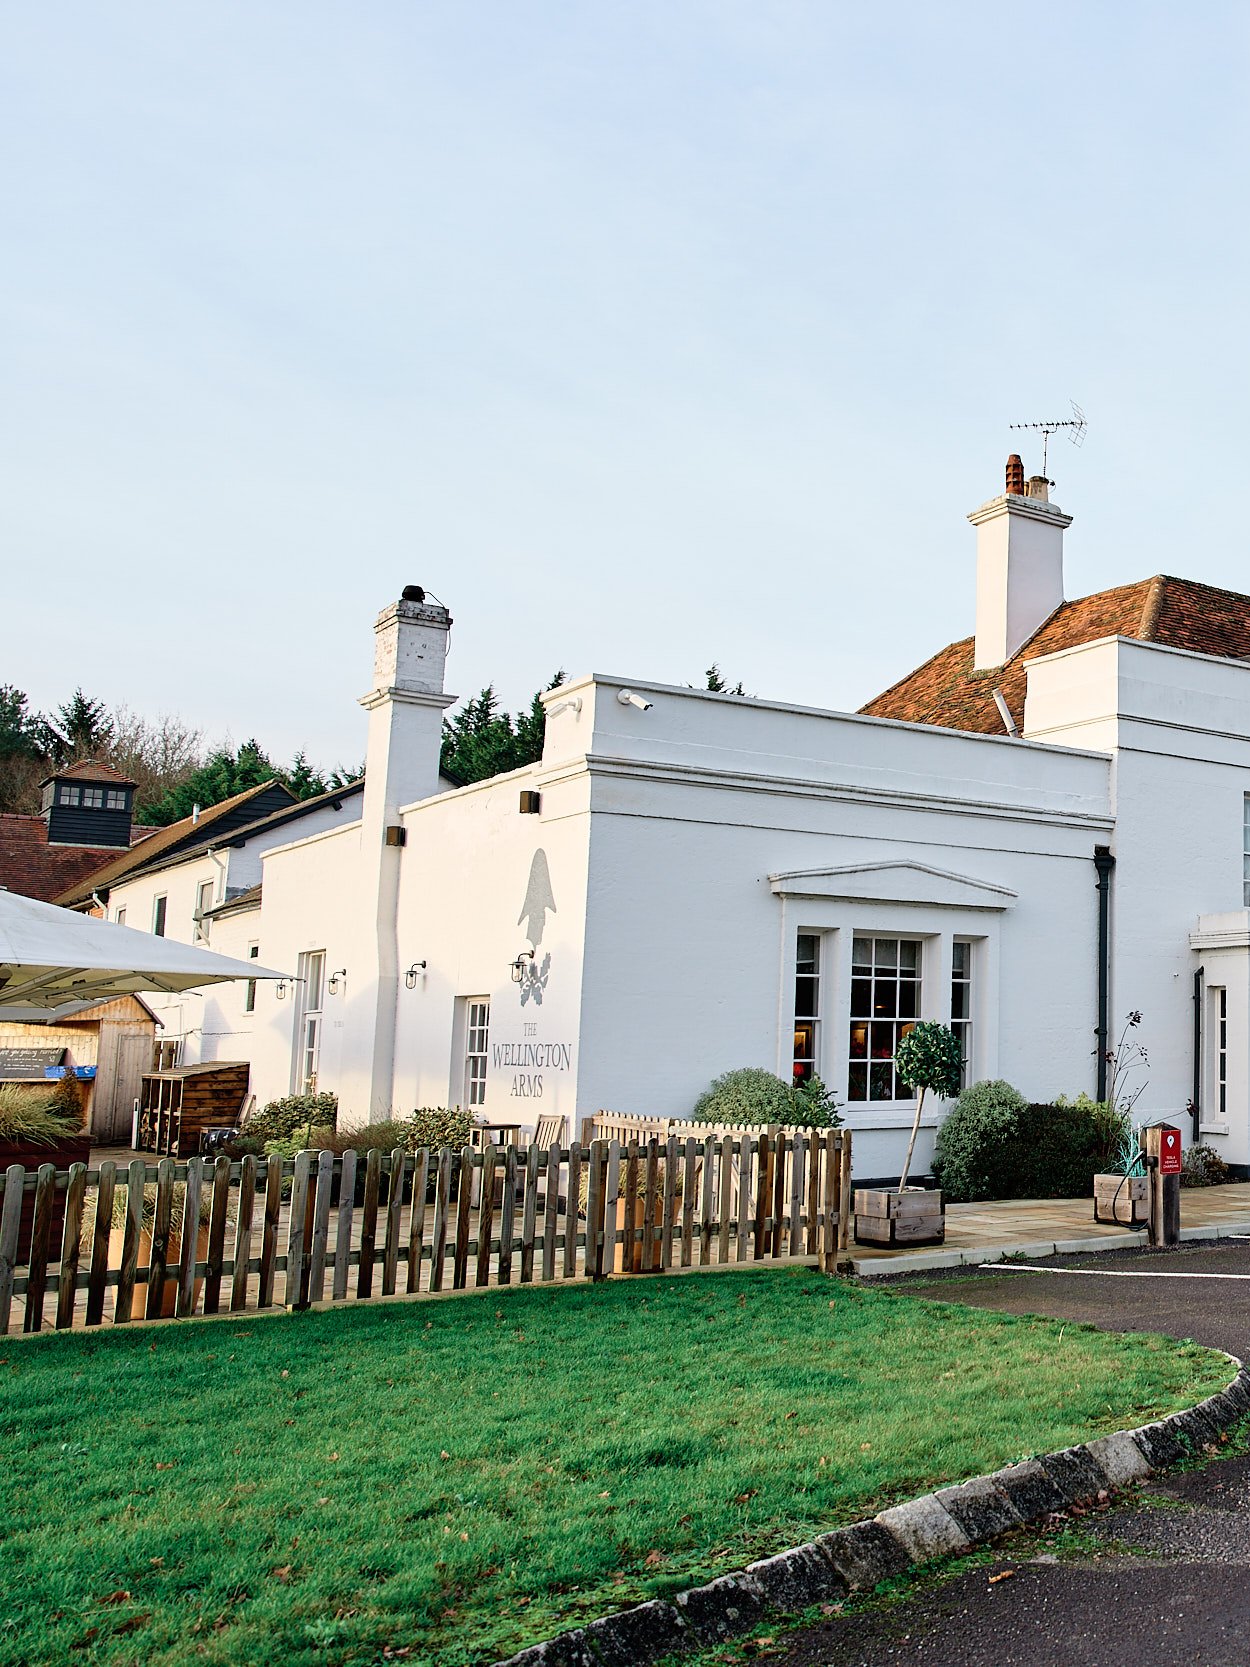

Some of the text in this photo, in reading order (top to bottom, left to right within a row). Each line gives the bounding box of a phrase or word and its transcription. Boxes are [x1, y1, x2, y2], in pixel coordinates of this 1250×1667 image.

[523, 1022, 538, 1037] THE
[492, 1043, 572, 1071] WELLINGTON
[510, 1074, 543, 1098] ARMS
